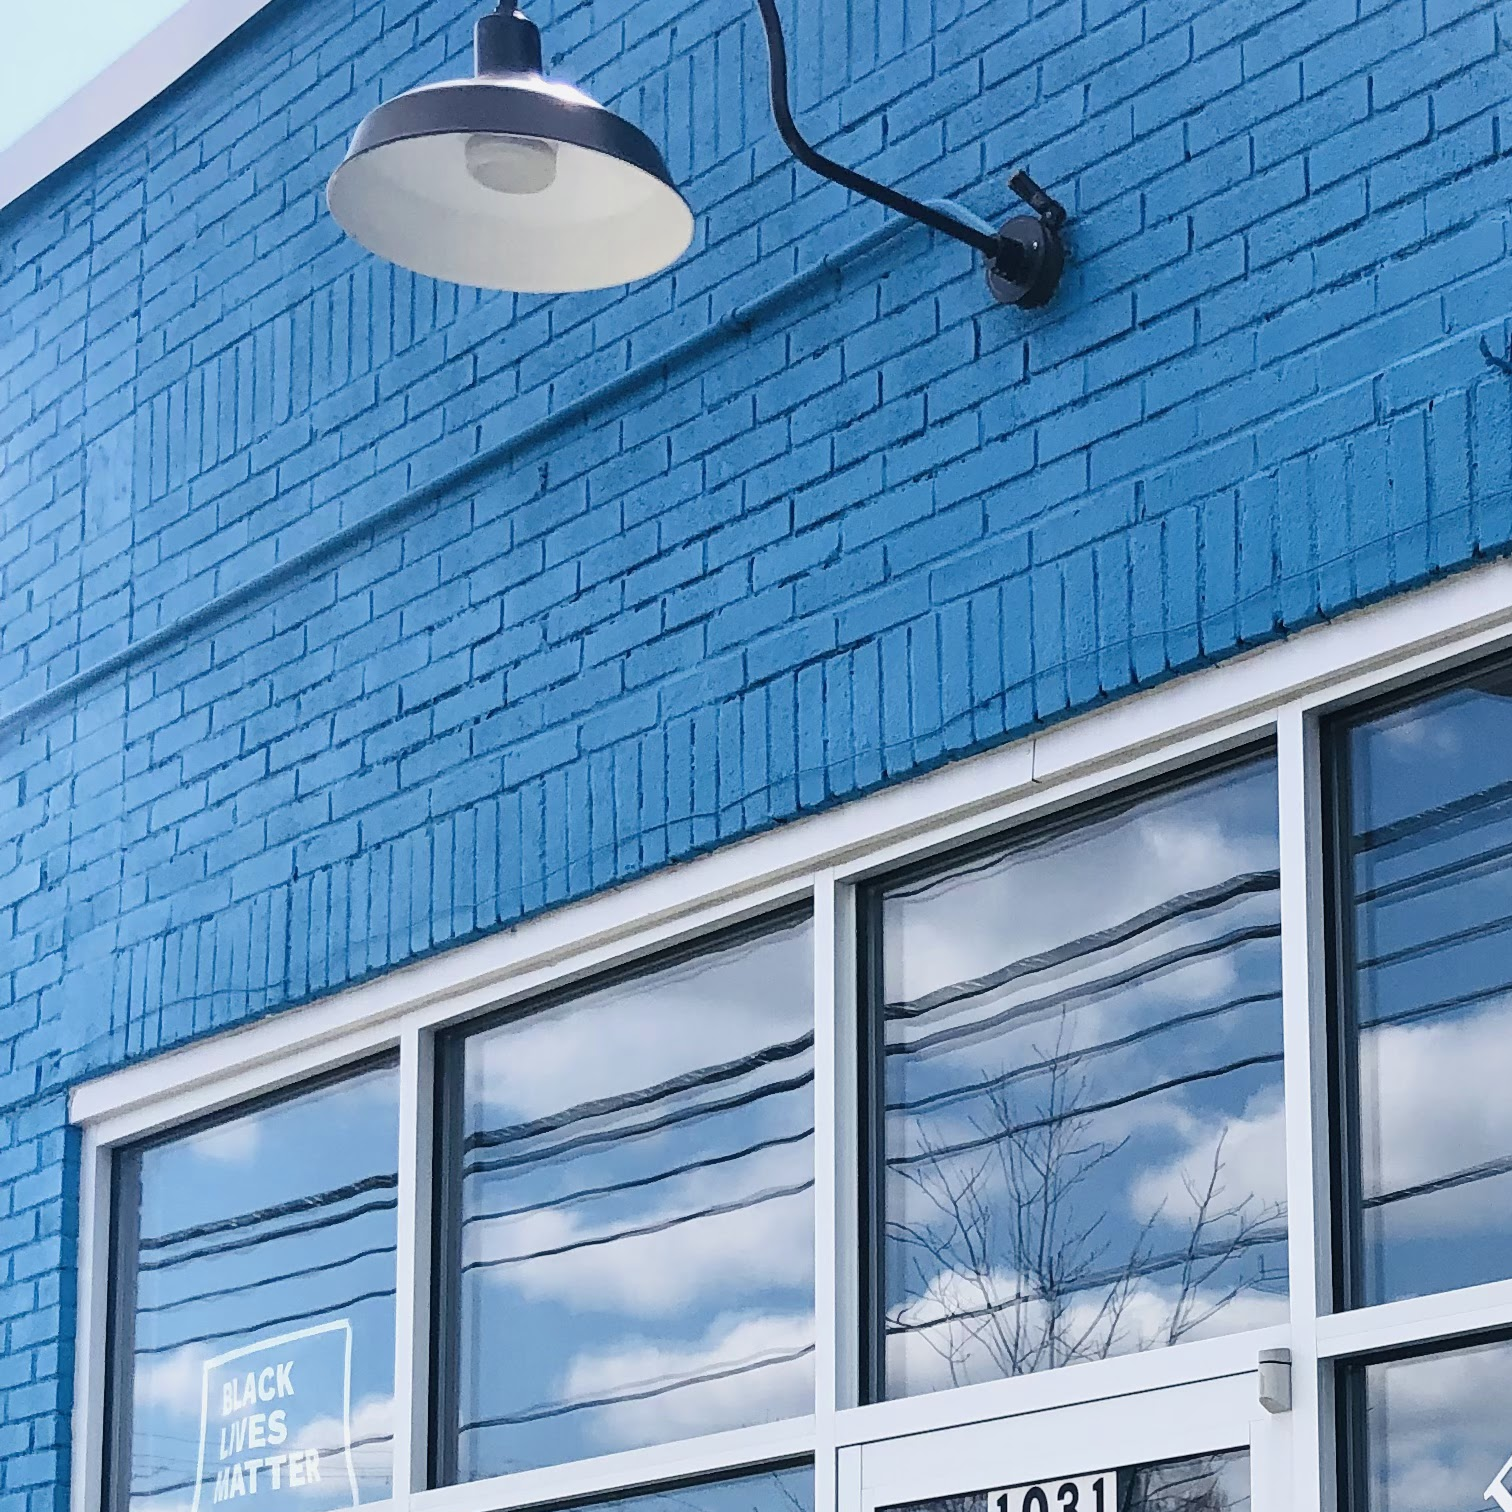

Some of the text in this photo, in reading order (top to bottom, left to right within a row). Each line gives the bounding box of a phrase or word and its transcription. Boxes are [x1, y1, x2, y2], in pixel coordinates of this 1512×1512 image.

[222, 1361, 294, 1416] BLACK
[220, 1410, 287, 1460] LIVES
[214, 1448, 321, 1504] MATTER
